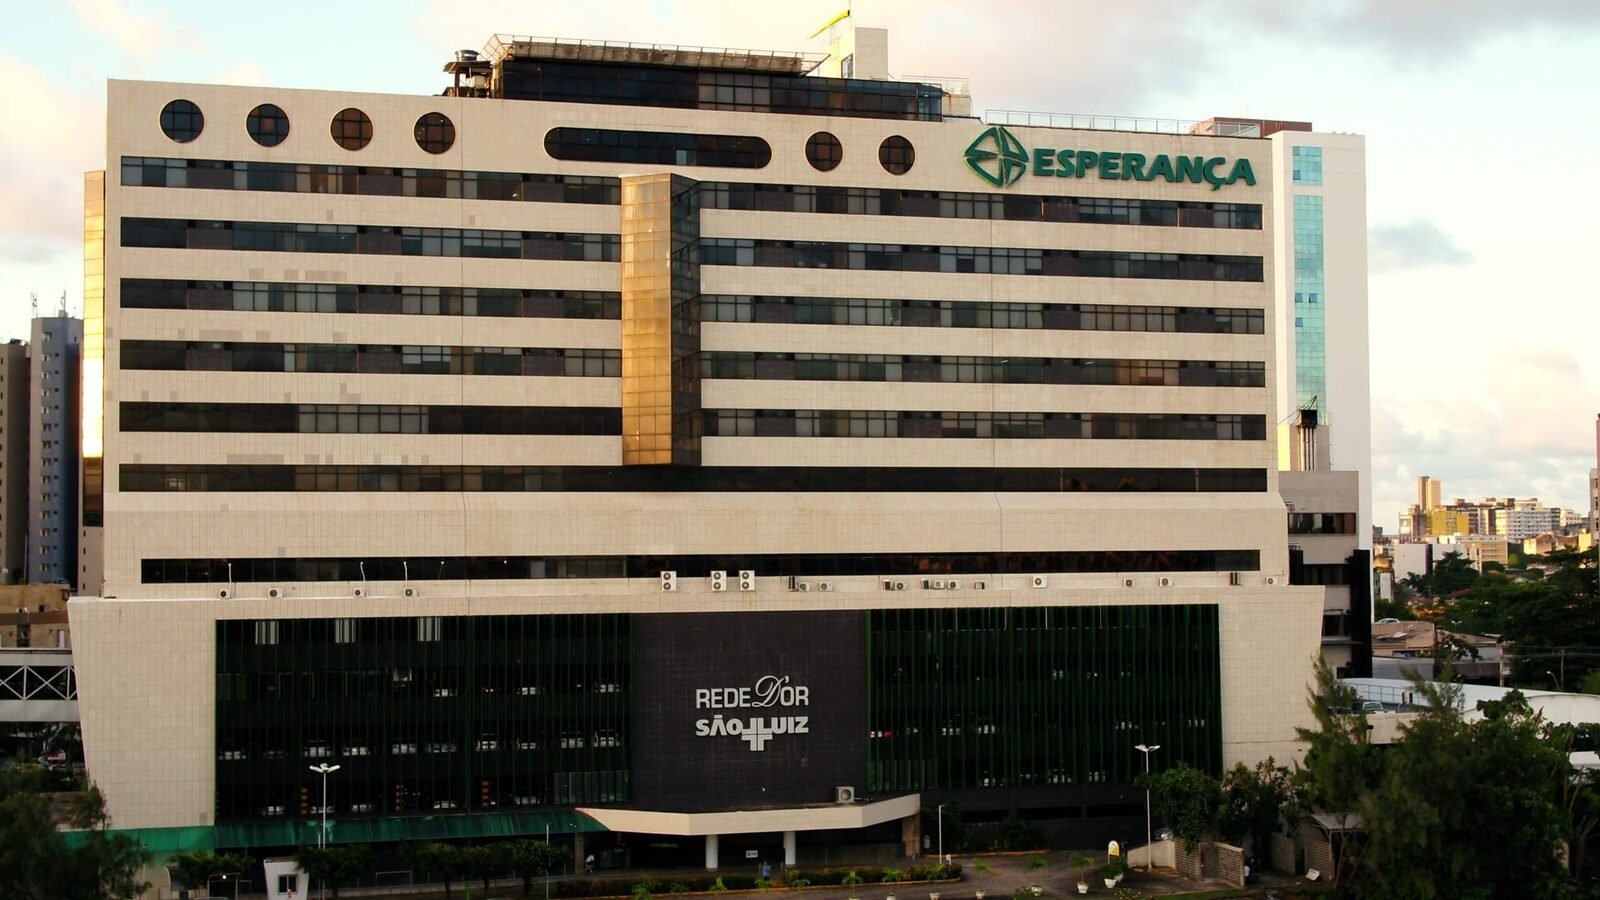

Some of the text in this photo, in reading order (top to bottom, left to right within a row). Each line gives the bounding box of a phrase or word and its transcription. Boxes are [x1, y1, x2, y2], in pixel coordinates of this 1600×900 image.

[1033, 148, 1256, 191] ESPERANÇA
[696, 687, 751, 708] REDE
[695, 714, 809, 736] SÃO LUIZ
